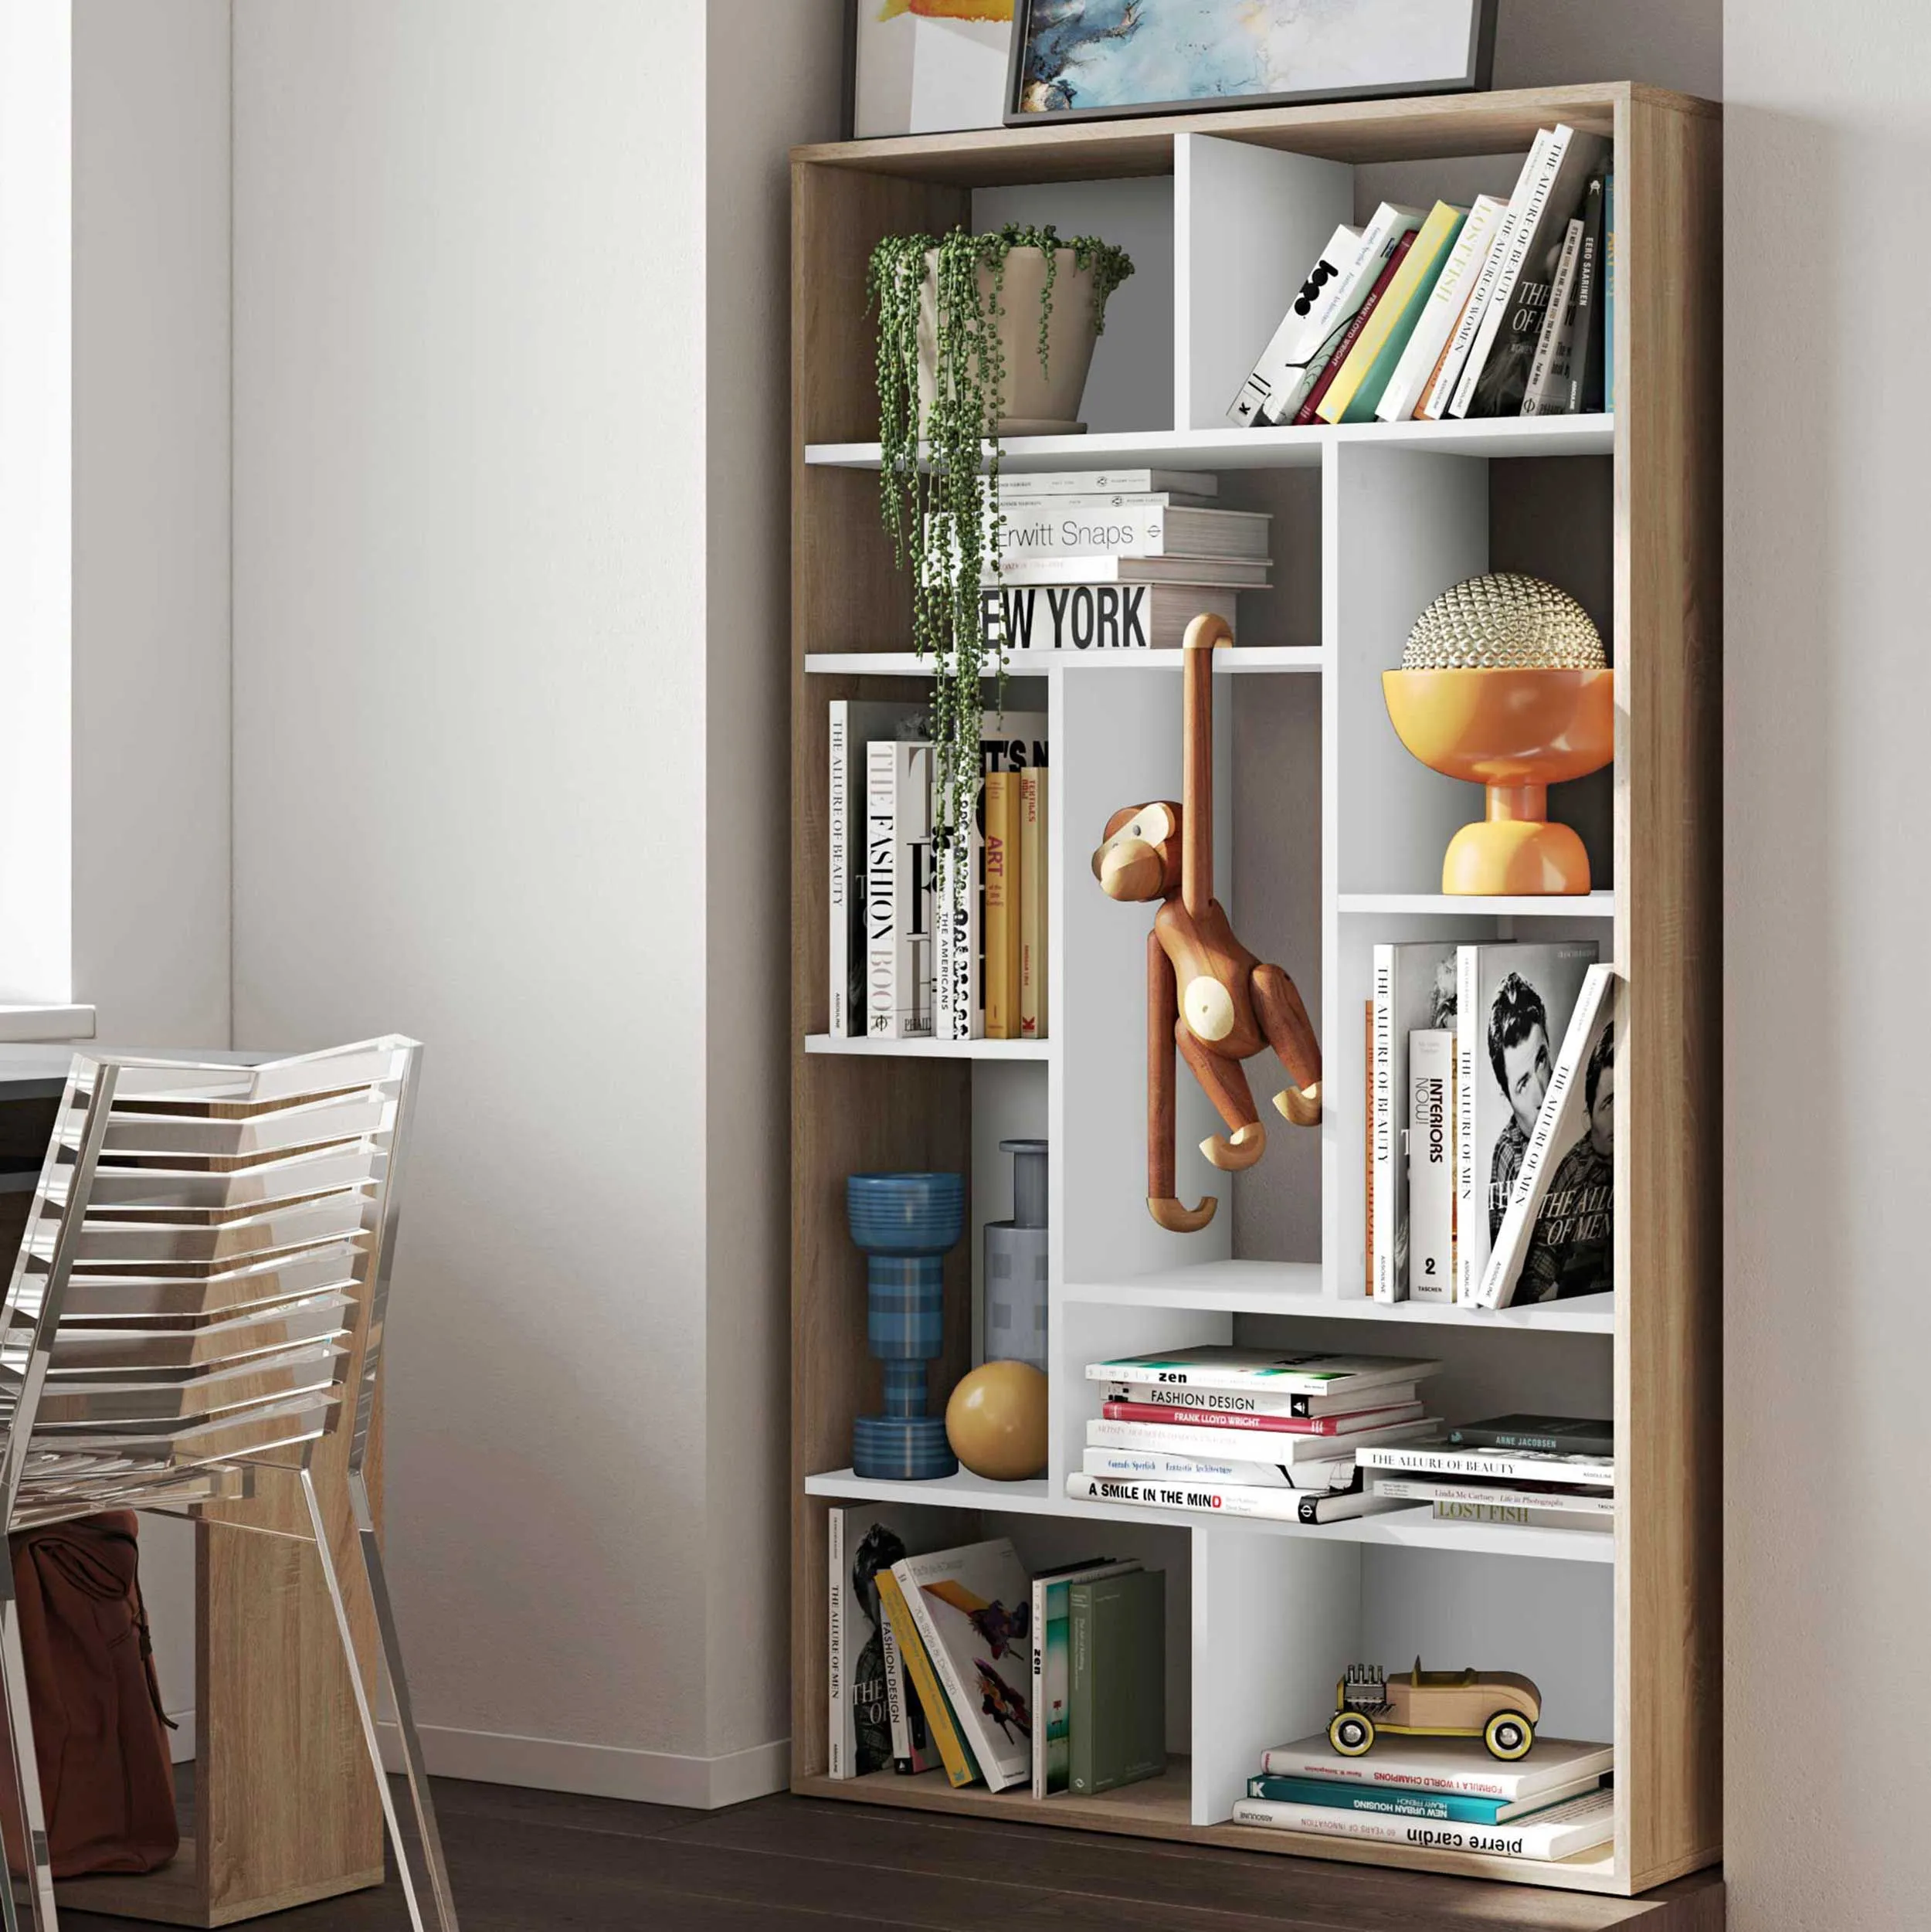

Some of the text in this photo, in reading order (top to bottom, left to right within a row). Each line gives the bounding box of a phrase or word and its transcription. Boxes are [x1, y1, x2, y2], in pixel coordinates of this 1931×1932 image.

[1542, 142, 1562, 171] THE
[1522, 173, 1550, 228] ALLURE
[1514, 227, 1531, 249] OF
[1435, 202, 1492, 303] LOST FISH
[1454, 212, 1516, 354] THE ALLURE OF WOMEN
[1492, 248, 1522, 306] BEAUTY
[1579, 236, 1593, 305] EERO SAARINEN
[1358, 291, 1377, 317] FRANK
[1346, 314, 1364, 339] LLOYD
[1330, 336, 1352, 367] WRIGHT
[1061, 521, 1134, 549] Snaps
[1047, 586, 1146, 650] YORK
[870, 745, 892, 806] THE
[833, 722, 842, 907] THE ALLURE OF BEAUTY
[987, 834, 1003, 877] ART
[870, 815, 892, 939] FASHION
[1377, 966, 1388, 1163] THE ALLURE OF BEAUTY
[1415, 1078, 1429, 1125] NOW!
[1430, 1078, 1443, 1163] INTERIORS
[1462, 1049, 1471, 1199] THE ALLURE OF MEN
[1514, 1064, 1569, 1207] THE ALLURE OF MEN
[1538, 1190, 1576, 1219] THE
[1547, 1219, 1575, 1245] OF
[1425, 1258, 1436, 1275] 2
[1158, 1371, 1187, 1383] zen
[1150, 1390, 1254, 1410] FASHION DESIGN
[1174, 1411, 1260, 1428] FRANK LLOYD WRIGHT
[1496, 1436, 1556, 1448] ARNE JACOBSEN
[1371, 1453, 1516, 1474] THE ALLURE OF BEAUTY
[1088, 1482, 1098, 1496] A
[1101, 1484, 1139, 1499] SMILE
[1142, 1488, 1156, 1501] IN
[1159, 1489, 1184, 1503] THE
[1186, 1492, 1222, 1507] MIND
[1434, 1489, 1454, 1497] Linda
[1521, 1496, 1563, 1508] Photographs
[1438, 1500, 1529, 1523] LOST FISH
[831, 1656, 839, 1671] OF
[881, 1621, 901, 1723] FASHION DESIGN
[853, 1678, 883, 1706] THE
[1373, 1771, 1422, 1784] CHAMPIONS
[1423, 1777, 1454, 1788] WORLD
[1462, 1781, 1502, 1794] FORMULA
[1239, 1810, 1273, 1822] ASSOULINE
[1353, 1799, 1447, 1818] NEW URBAN HOUSING
[1396, 1798, 1447, 1809] HILARY FRENCH
[1301, 1815, 1396, 1837] 60 YEARS OF INNOVATION
[1404, 1825, 1523, 1856] pierre cardin
